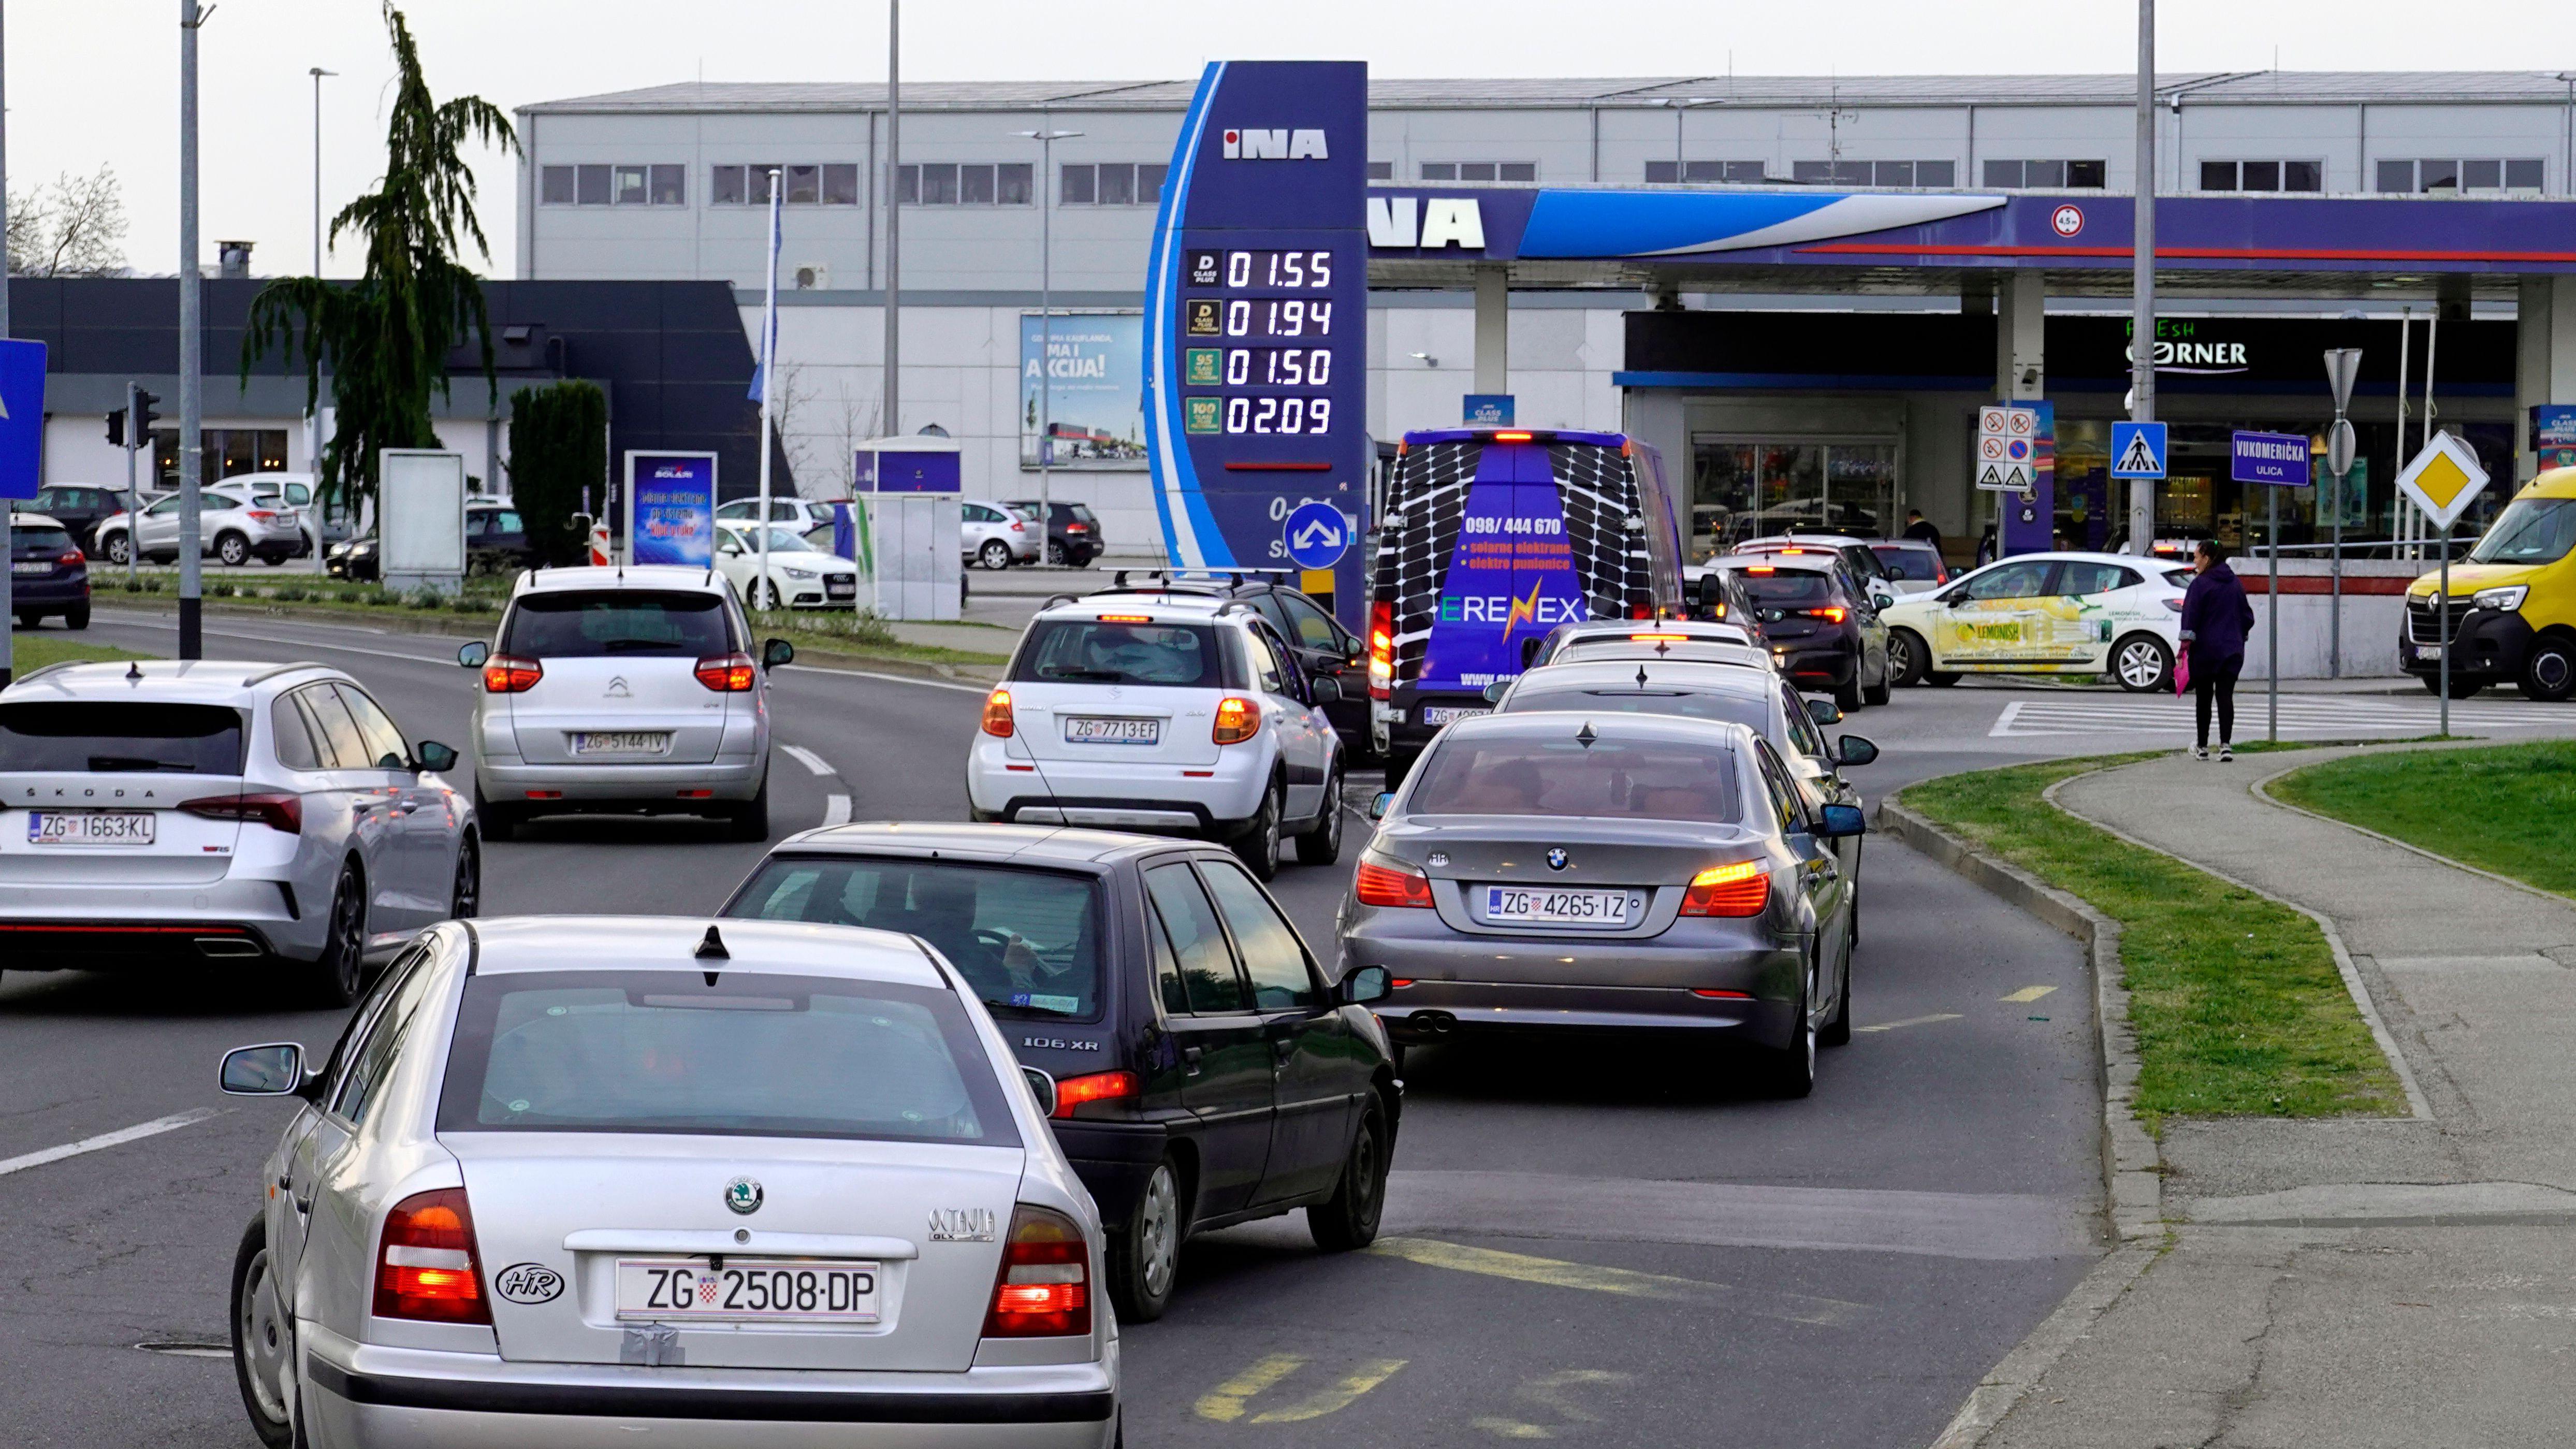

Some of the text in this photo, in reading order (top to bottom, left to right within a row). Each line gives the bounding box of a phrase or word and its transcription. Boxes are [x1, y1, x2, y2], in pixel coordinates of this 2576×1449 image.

[1366, 198, 1485, 248] NA
[1198, 255, 1214, 269] D
[1198, 305, 1212, 317] D
[2126, 319, 2194, 337] FESH
[1025, 354, 1105, 378] AKCIJA!
[1196, 354, 1214, 366] 95
[1193, 403, 1216, 414] 100
[1227, 398, 1331, 433] 02.09
[2236, 440, 2305, 462] VUKOMERIČKA
[2256, 466, 2283, 476] ULICA
[1465, 517, 1561, 535] 098/ 444 670
[1433, 710, 1448, 722] ZG
[1076, 721, 1093, 736] ZG
[43, 817, 66, 836] ZG
[1504, 893, 1529, 914] ZG
[1023, 1037, 1099, 1051] 106 XR
[928, 1208, 995, 1233] OCTAVIA
[505, 1271, 556, 1297] HR
[647, 1269, 693, 1309] ZG
